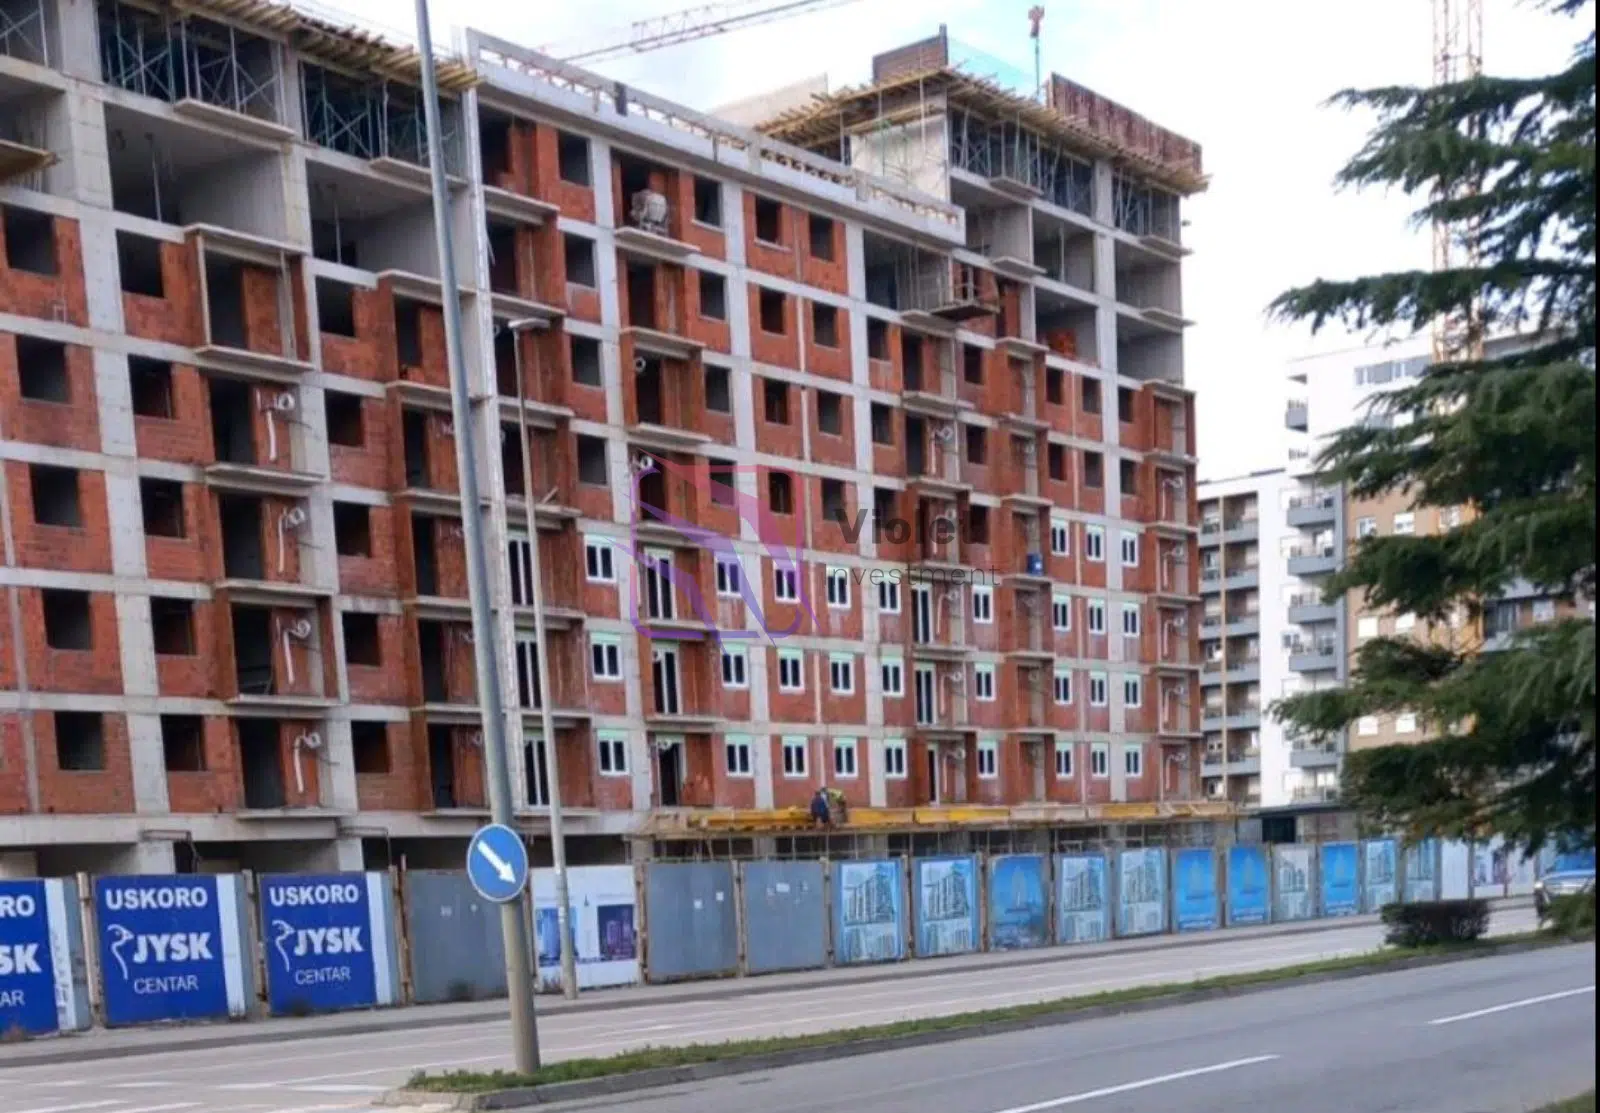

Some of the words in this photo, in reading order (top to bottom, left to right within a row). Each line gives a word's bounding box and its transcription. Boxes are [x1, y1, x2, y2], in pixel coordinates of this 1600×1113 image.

[105, 887, 208, 910] USKORO
[269, 884, 359, 907] USKORO
[133, 931, 214, 964] JYSK
[294, 927, 364, 957] JYSK
[134, 974, 199, 994] CENTAR
[295, 967, 351, 985] CENTAR
